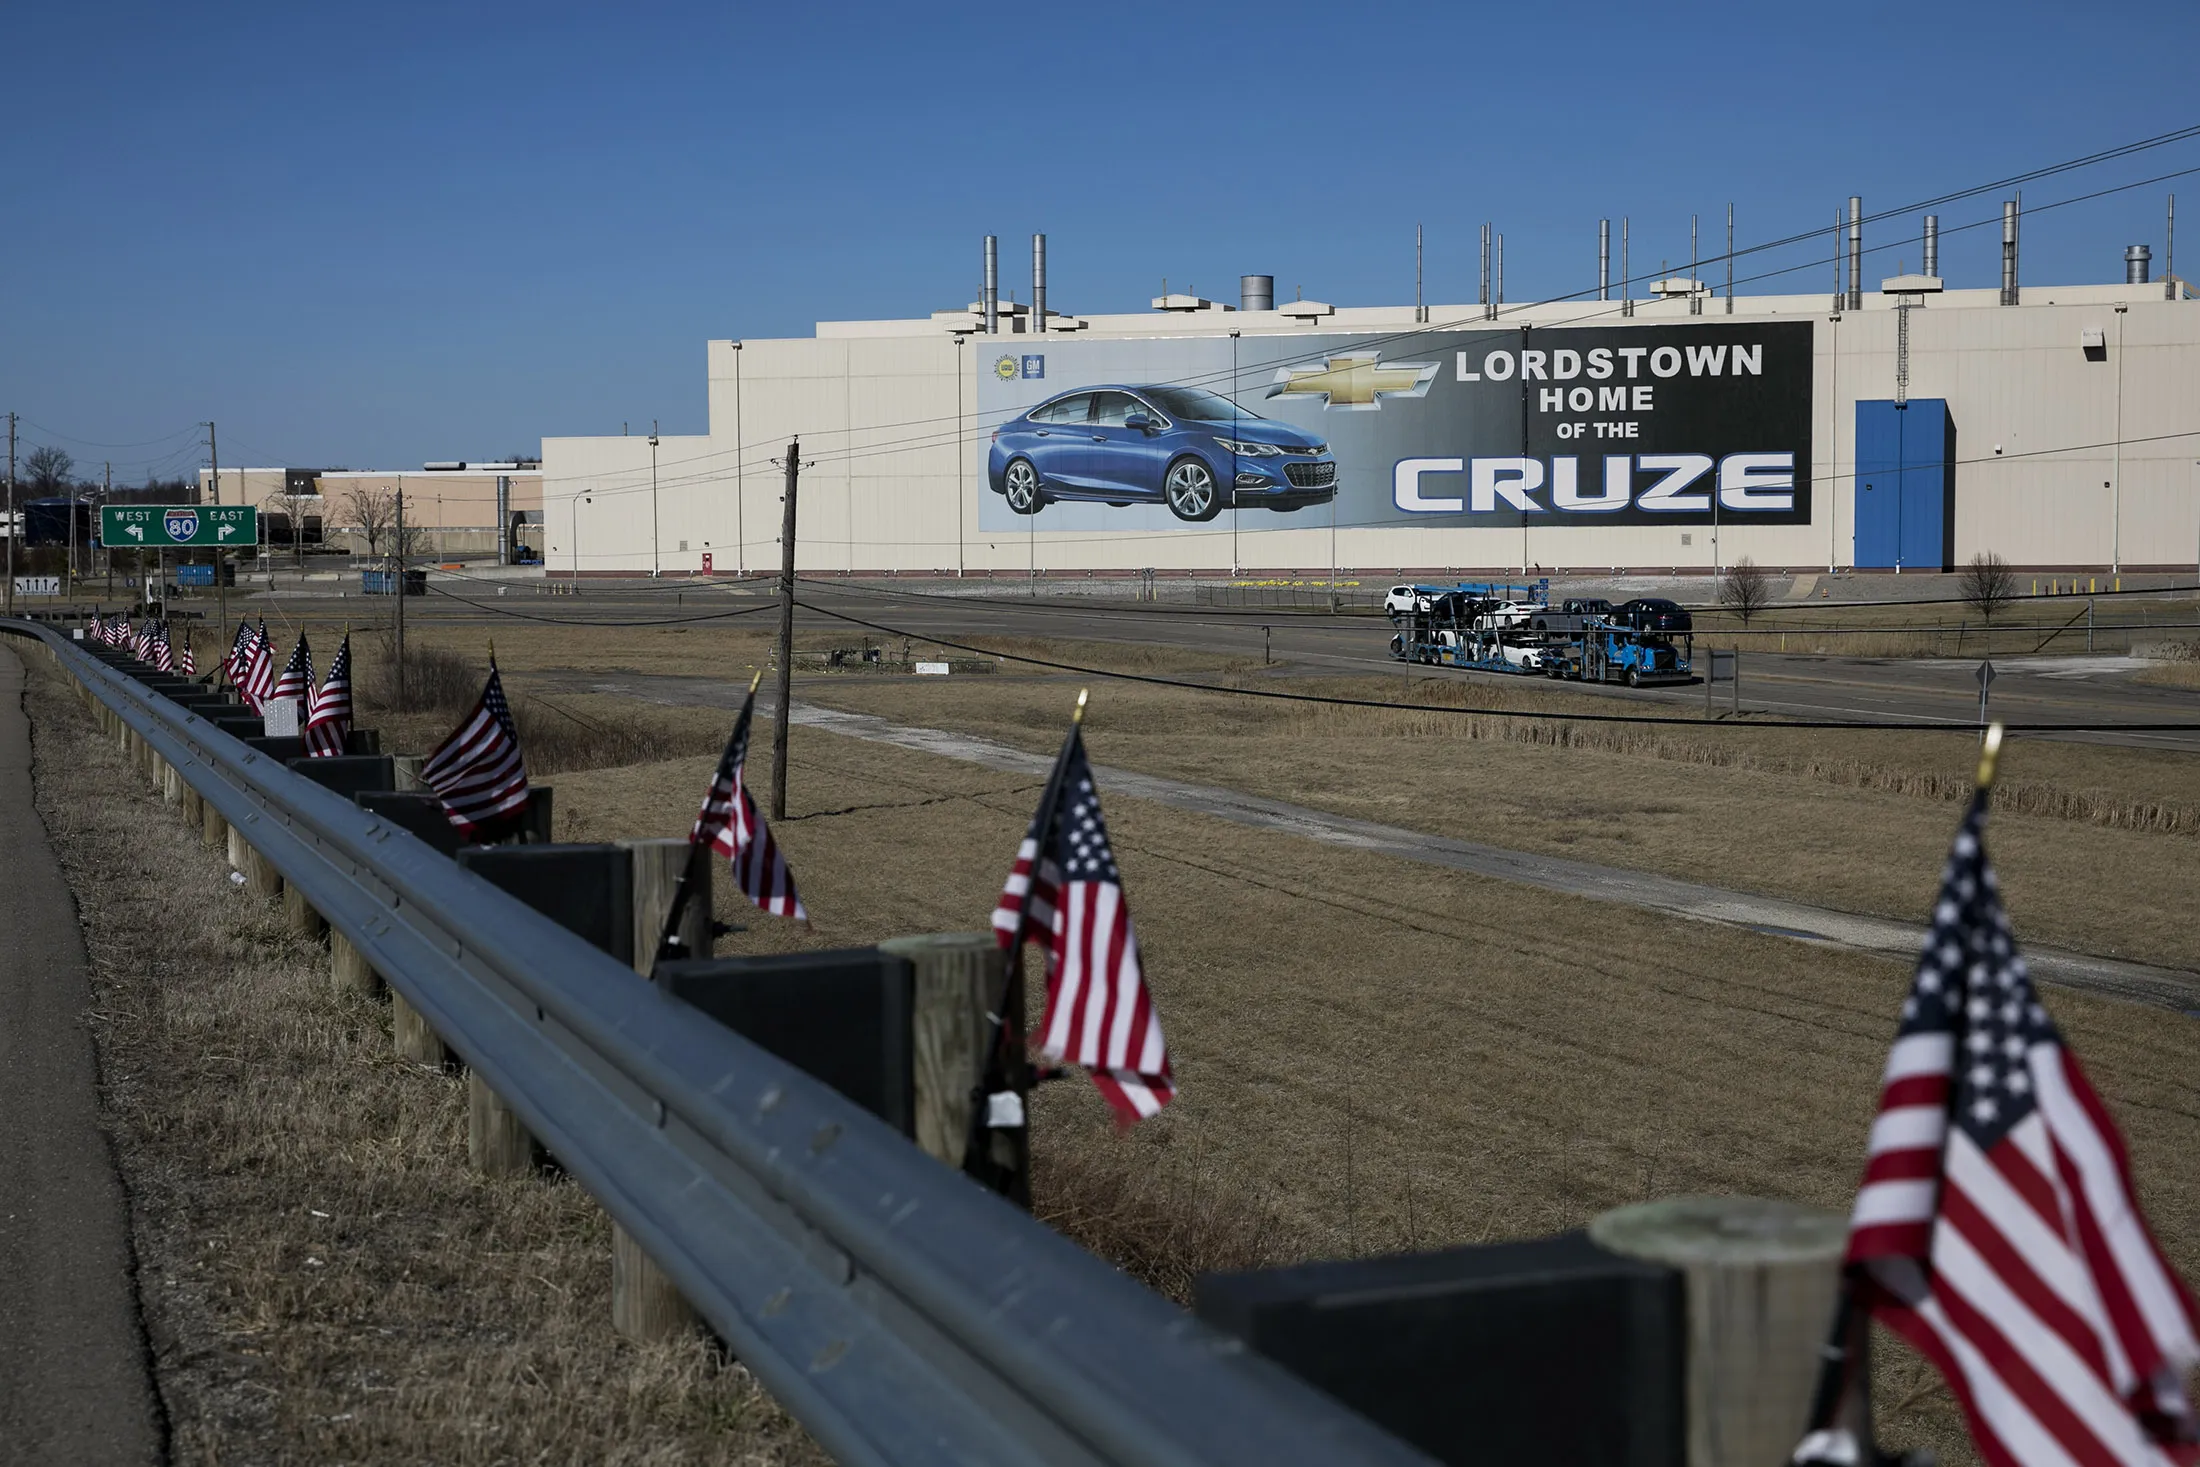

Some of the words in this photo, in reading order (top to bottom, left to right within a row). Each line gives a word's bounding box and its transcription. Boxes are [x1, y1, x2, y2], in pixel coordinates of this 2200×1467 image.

[1026, 359, 1040, 370] GM
[1456, 344, 1762, 382] LORDSTOWN
[1539, 386, 1654, 413] HOME
[1556, 422, 1586, 439] OF
[1592, 421, 1639, 438] THE
[1393, 452, 1795, 513] CRUZE
[114, 511, 151, 521] WEST
[209, 510, 244, 521] EAST
[169, 519, 194, 536] 80
